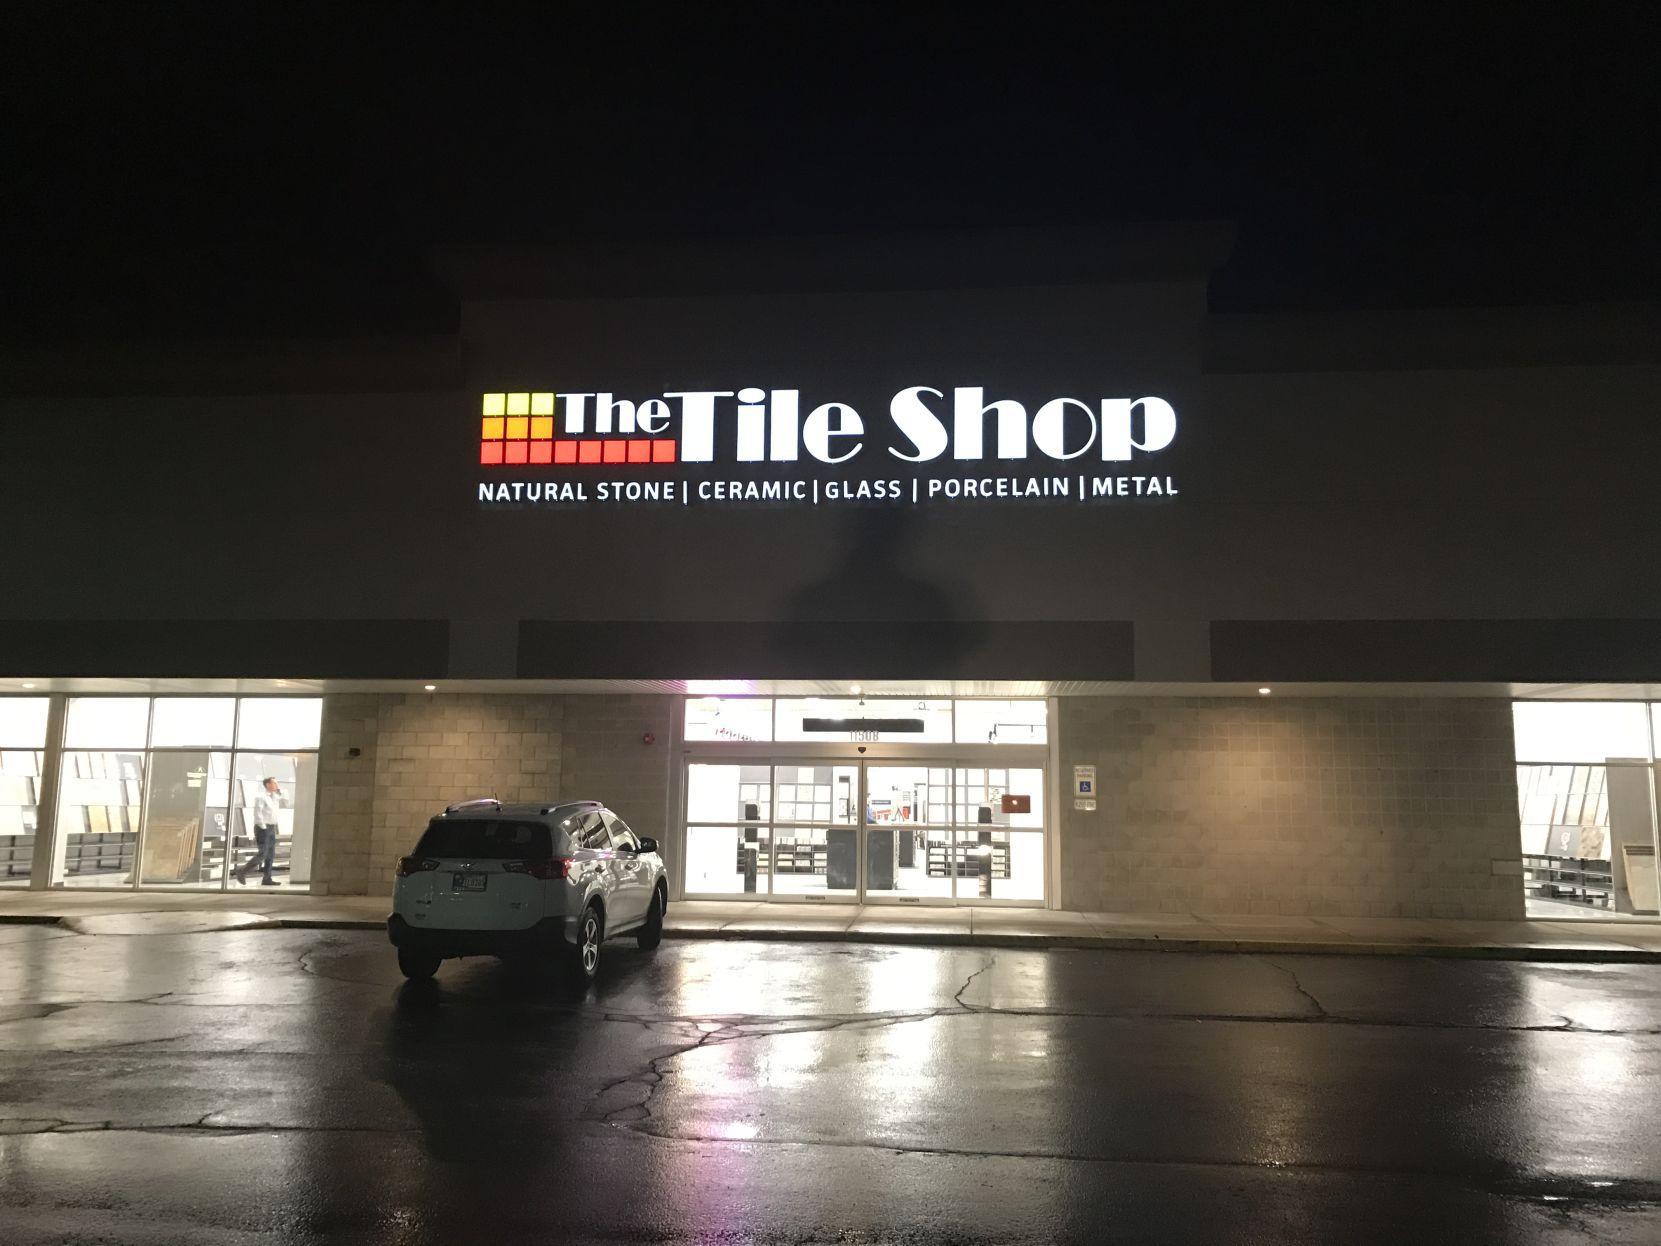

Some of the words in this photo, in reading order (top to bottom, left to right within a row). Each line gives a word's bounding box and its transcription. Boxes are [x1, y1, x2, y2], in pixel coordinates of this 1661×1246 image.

[556, 393, 671, 434] The
[663, 388, 865, 464] Tile
[888, 386, 1177, 463] Shop
[479, 482, 588, 502] NATURAL
[597, 481, 675, 501] STONE
[698, 481, 806, 501] CERAMIC
[825, 479, 901, 500] GLASS
[928, 477, 1069, 498] PORCELAIN
[1092, 476, 1178, 497] METAL
